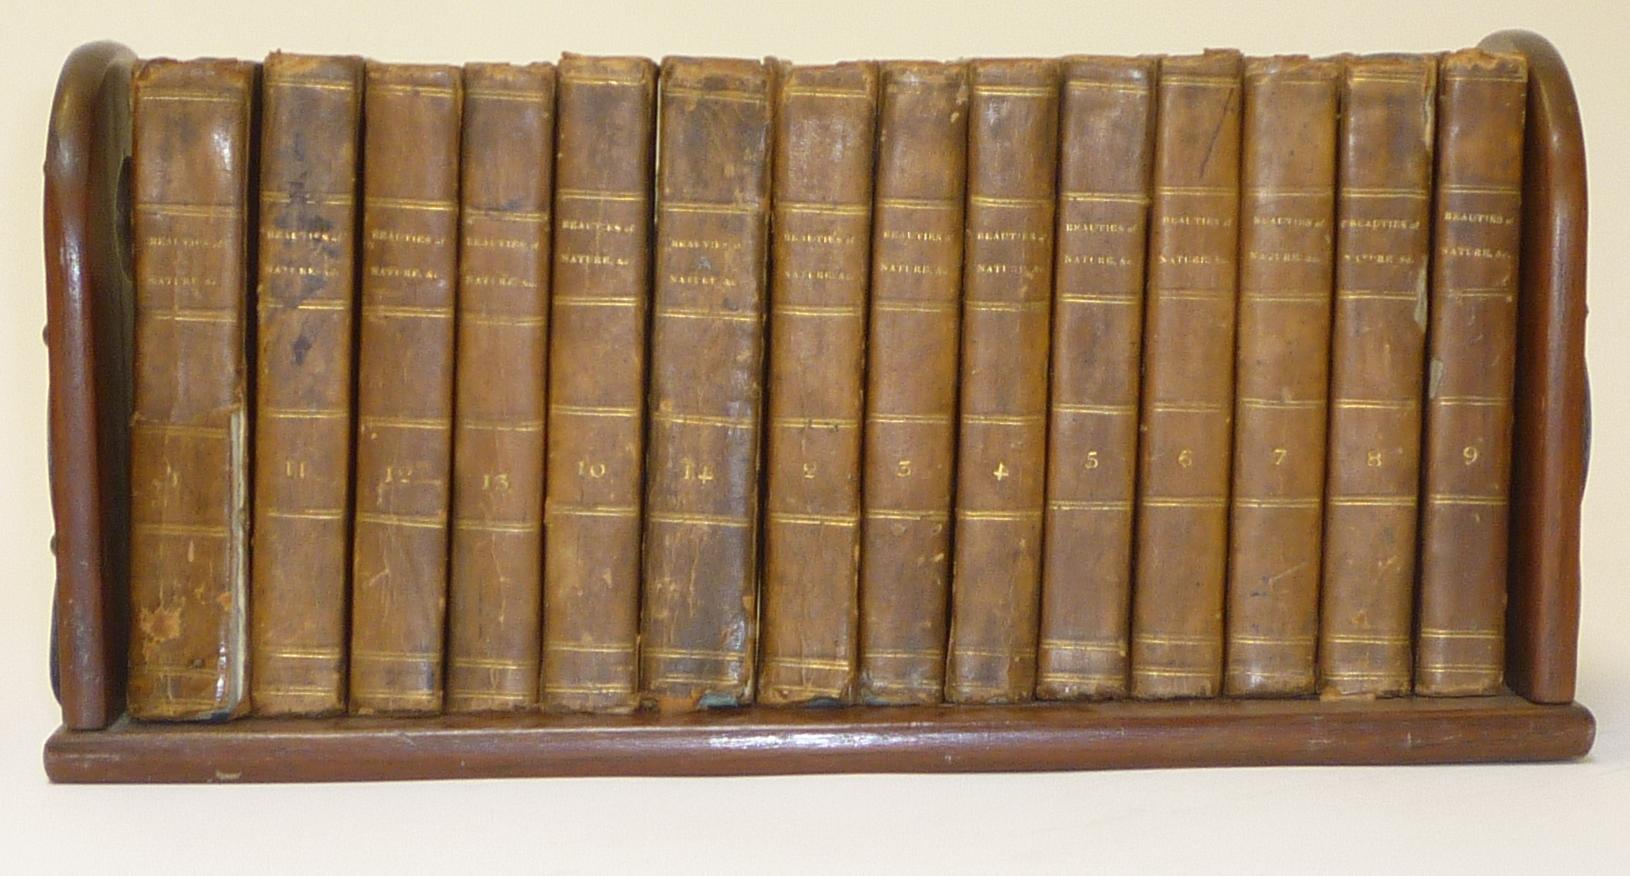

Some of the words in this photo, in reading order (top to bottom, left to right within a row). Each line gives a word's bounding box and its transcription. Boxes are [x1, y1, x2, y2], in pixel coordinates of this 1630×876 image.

[562, 220, 621, 233] BEAUTIES
[1163, 216, 1220, 226] BEAUTIES
[1445, 212, 1504, 224] BEAUTIES
[372, 230, 431, 243] BEAUTIES
[977, 232, 1036, 241] BEAUTIES
[1066, 223, 1124, 233] BEAUTIES
[1085, 451, 1098, 469] 5
[1178, 450, 1192, 468] 6
[1274, 449, 1287, 465] 7
[1367, 450, 1383, 467] 8
[1463, 446, 1478, 466] 9
[286, 461, 305, 478] 11
[384, 466, 413, 484] 12
[578, 460, 605, 478] 10
[682, 459, 713, 484] 14
[897, 460, 911, 477] 3
[993, 463, 1009, 481] 4
[483, 474, 509, 490] 13
